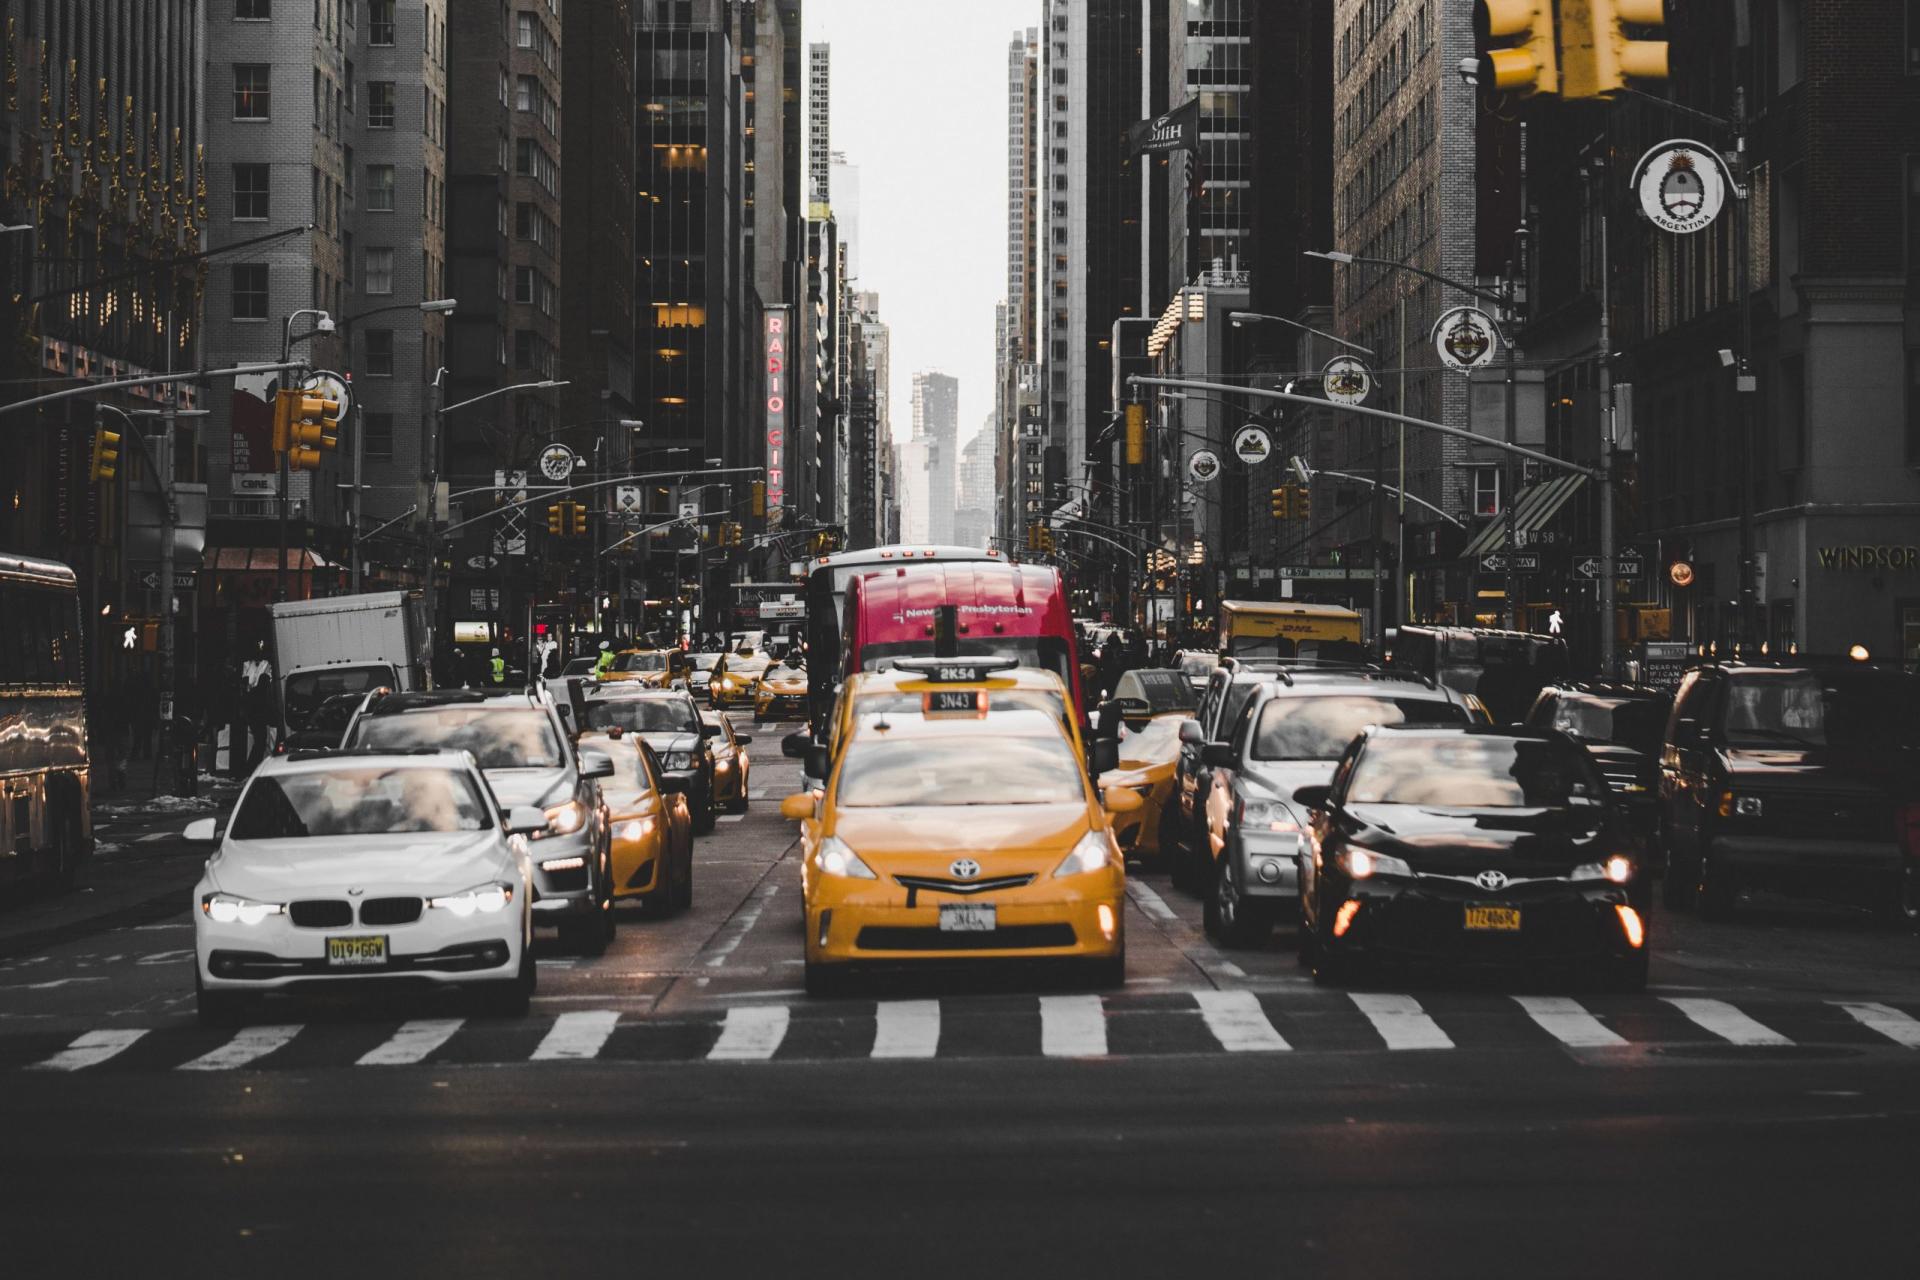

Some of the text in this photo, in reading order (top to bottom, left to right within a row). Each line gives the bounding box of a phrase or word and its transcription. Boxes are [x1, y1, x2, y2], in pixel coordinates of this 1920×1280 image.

[1654, 215, 1711, 231] ARGENTINA
[768, 317, 783, 505] RADIO CITY
[1529, 532, 1554, 544] W 58
[1817, 545, 1919, 568] WINDSOR
[1583, 562, 1598, 573] ON
[940, 667, 976, 680] 2K54
[940, 693, 969, 709] 3N43
